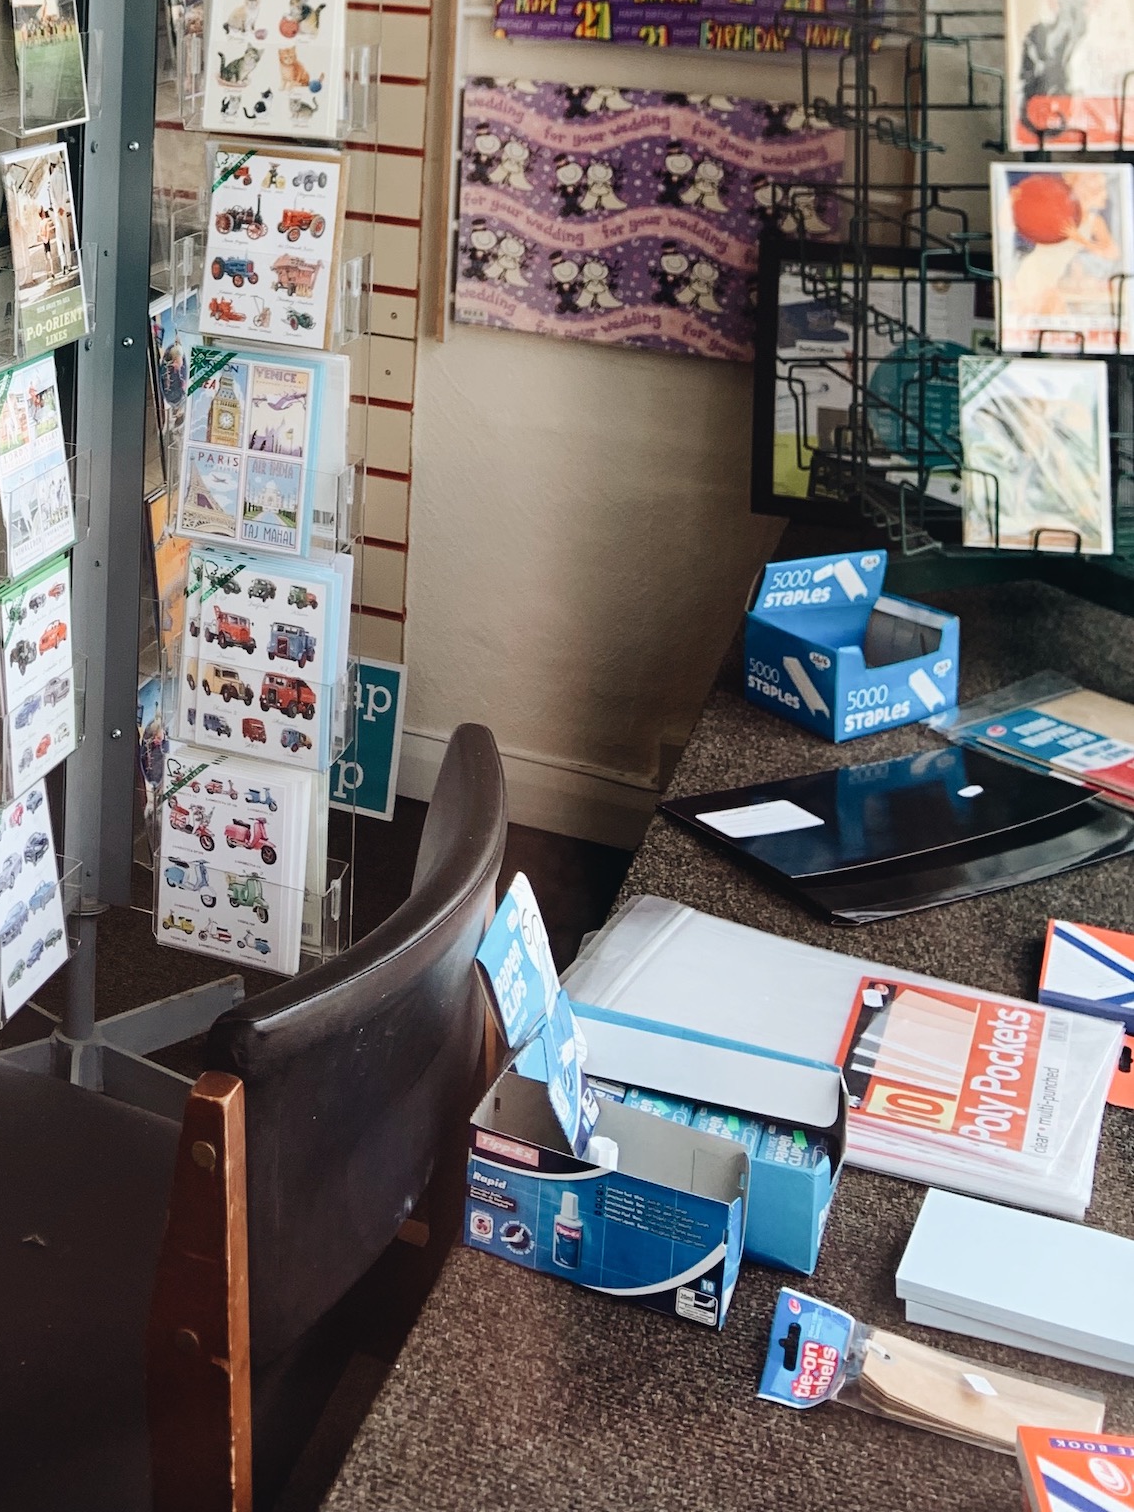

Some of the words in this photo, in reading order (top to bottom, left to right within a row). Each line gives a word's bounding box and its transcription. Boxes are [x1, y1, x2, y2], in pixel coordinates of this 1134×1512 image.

[575, 0, 612, 40] 21
[254, 366, 297, 384] VENICE
[197, 452, 239, 467] PARIS
[242, 523, 260, 539] TAJ
[263, 527, 295, 547] MAHAL
[770, 568, 812, 590] 5000
[749, 657, 781, 684] 5000
[846, 683, 889, 711] 5000
[969, 1007, 1032, 1097] Pockets
[882, 1093, 945, 1124] 10
[1038, 1067, 1060, 1126] multi-punched
[958, 1096, 1027, 1147] Poly
[481, 1135, 533, 1160] Tipp-Ex
[1033, 1129, 1049, 1154] clear
[472, 1171, 507, 1189] Rapid
[793, 1342, 819, 1398] tie-on
[1055, 1439, 1108, 1453] BOOK
